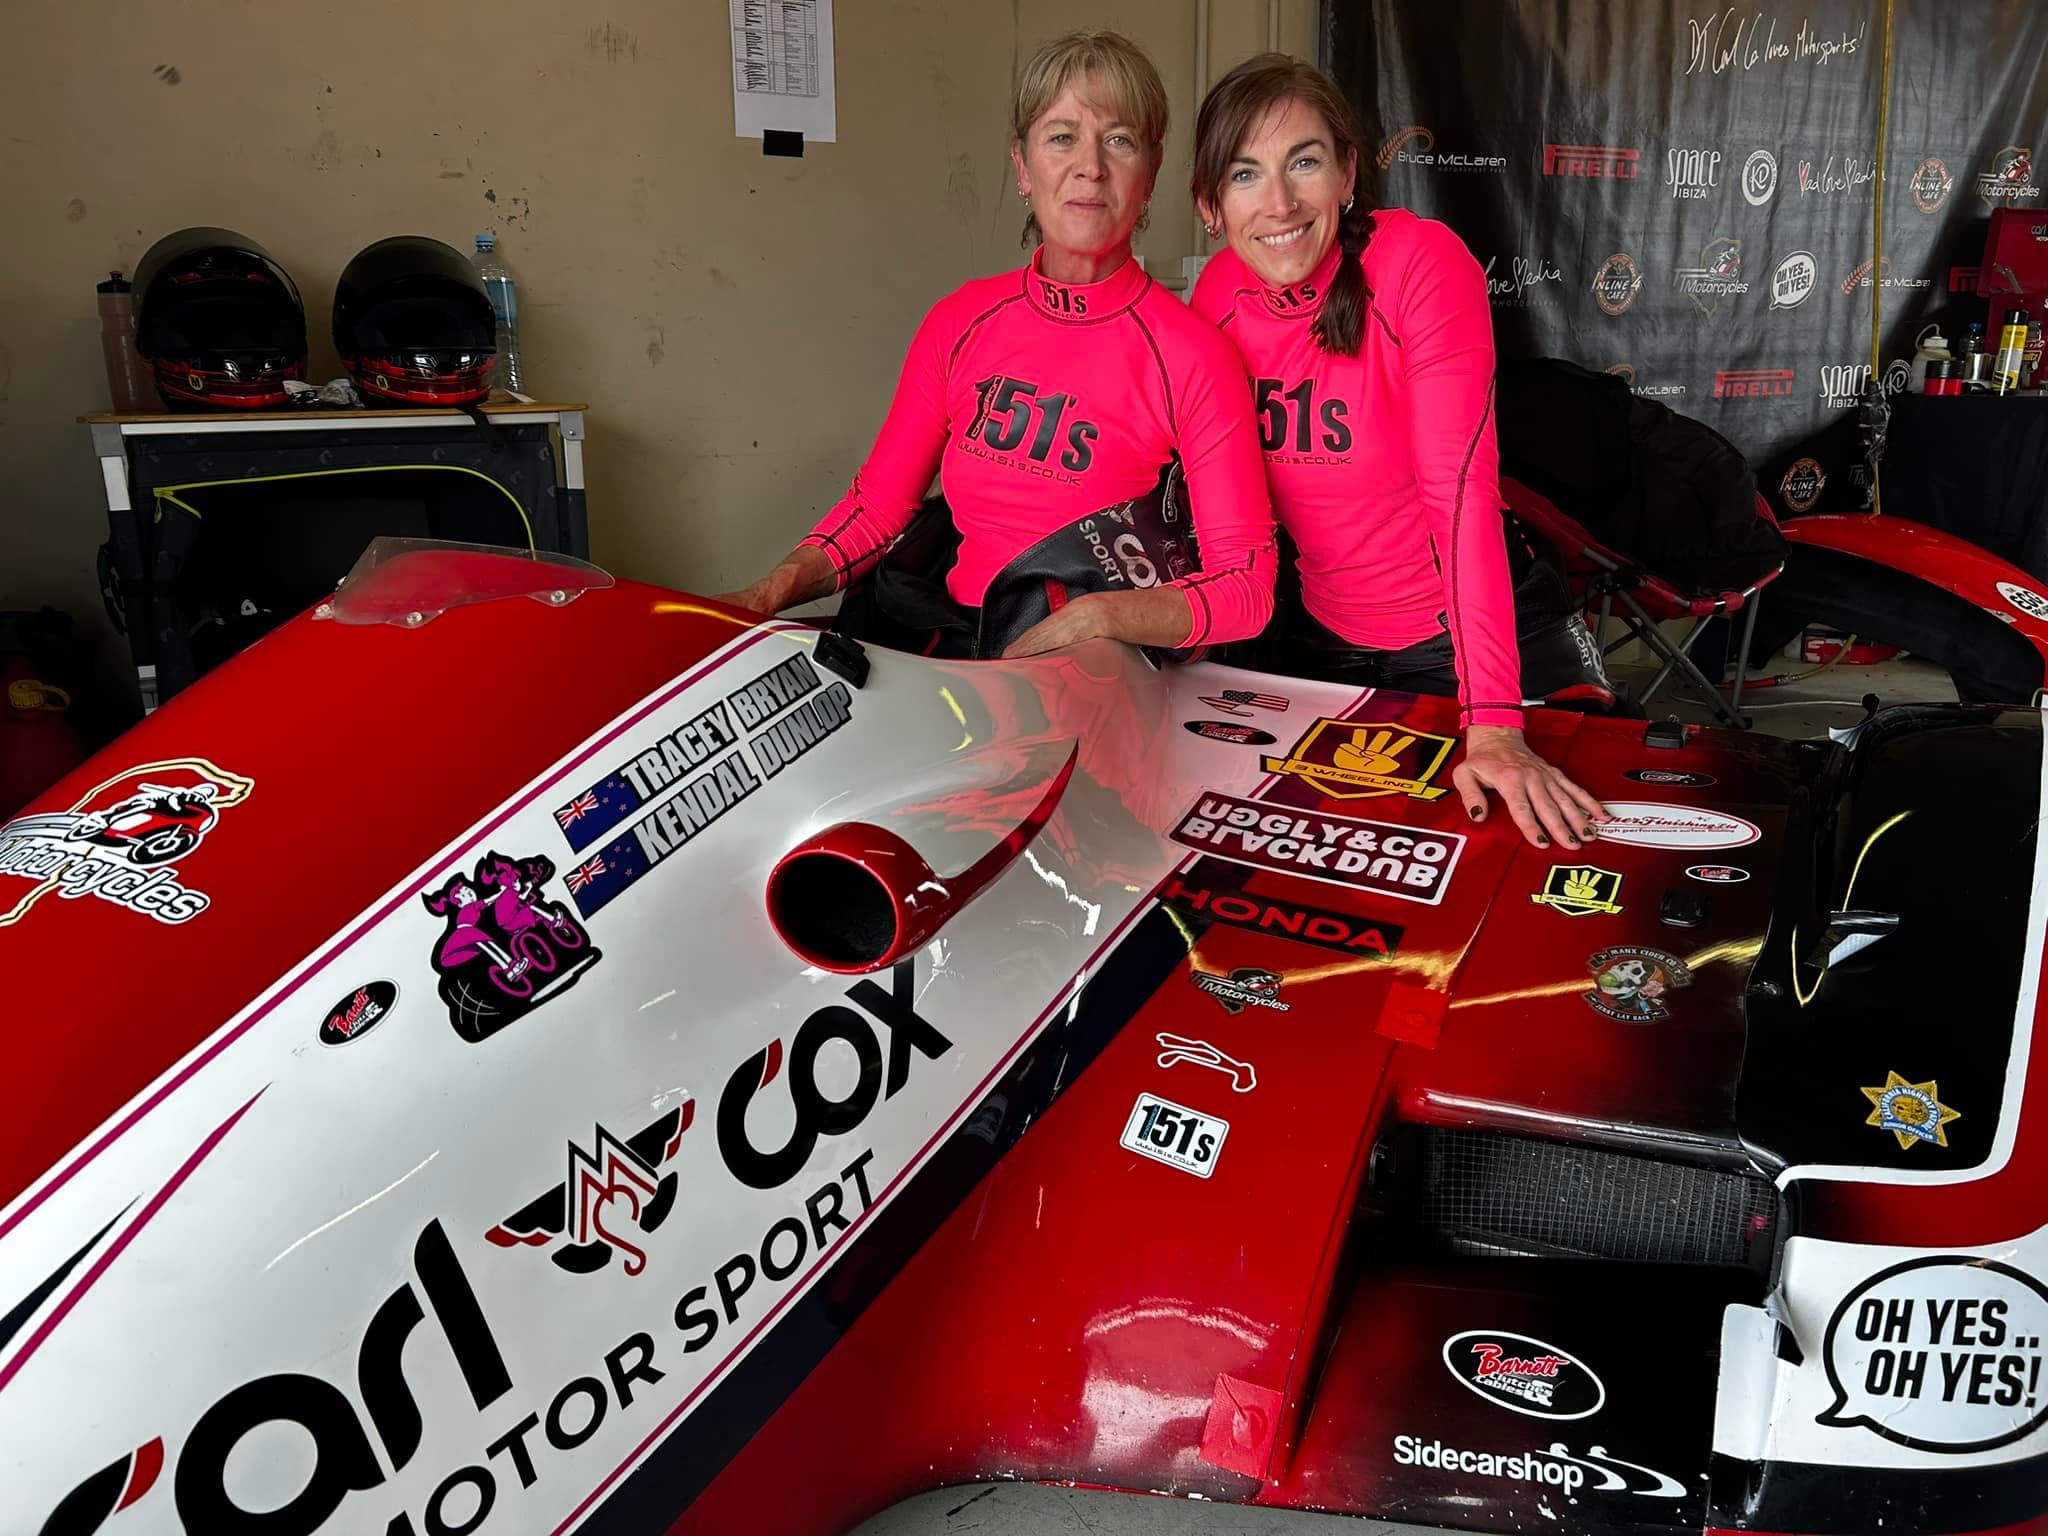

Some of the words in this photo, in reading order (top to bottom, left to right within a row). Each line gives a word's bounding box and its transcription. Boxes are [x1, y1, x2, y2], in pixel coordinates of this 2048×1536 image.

[1398, 150, 1435, 165] Bruce
[1438, 154, 1507, 168] McLaren
[1543, 144, 1640, 179] PIRELLI
[1678, 188, 1708, 199] IBIZA
[1942, 176, 1952, 192] 4
[1980, 184, 2040, 199] Motorcycles
[1592, 272, 1630, 290] INLINE
[1630, 275, 1642, 291] 4
[1607, 291, 1627, 299] CAFE
[1683, 279, 1748, 296] Motorcycles
[1860, 277, 1891, 287] Brce
[1637, 385, 1686, 396] McLaren
[1712, 368, 1796, 400] PIRELLI
[965, 374, 1099, 472] 151's
[1249, 376, 1353, 453] 51's
[1079, 519, 1125, 583] SPORT
[1566, 626, 1594, 669] PORT
[620, 701, 738, 801] TRACEY
[729, 653, 822, 732] BRYAN
[633, 750, 760, 865] KENDAL
[750, 682, 852, 780] DUNLOP
[1313, 768, 1414, 790] WHEELING
[1165, 879, 1390, 953] HONDA
[1610, 948, 1637, 956] MANX
[1639, 949, 1665, 961] CIDER
[1203, 982, 1290, 1012] Motorcycles
[1137, 1103, 1216, 1163] 151's
[673, 1149, 881, 1354] SPORT
[1855, 1298, 1914, 1343] OH
[1471, 1343, 1571, 1377] Barnett
[1865, 1348, 1928, 1400] OH
[1940, 1352, 2042, 1408] YES!
[1393, 1434, 1584, 1496] Sidecarshop
